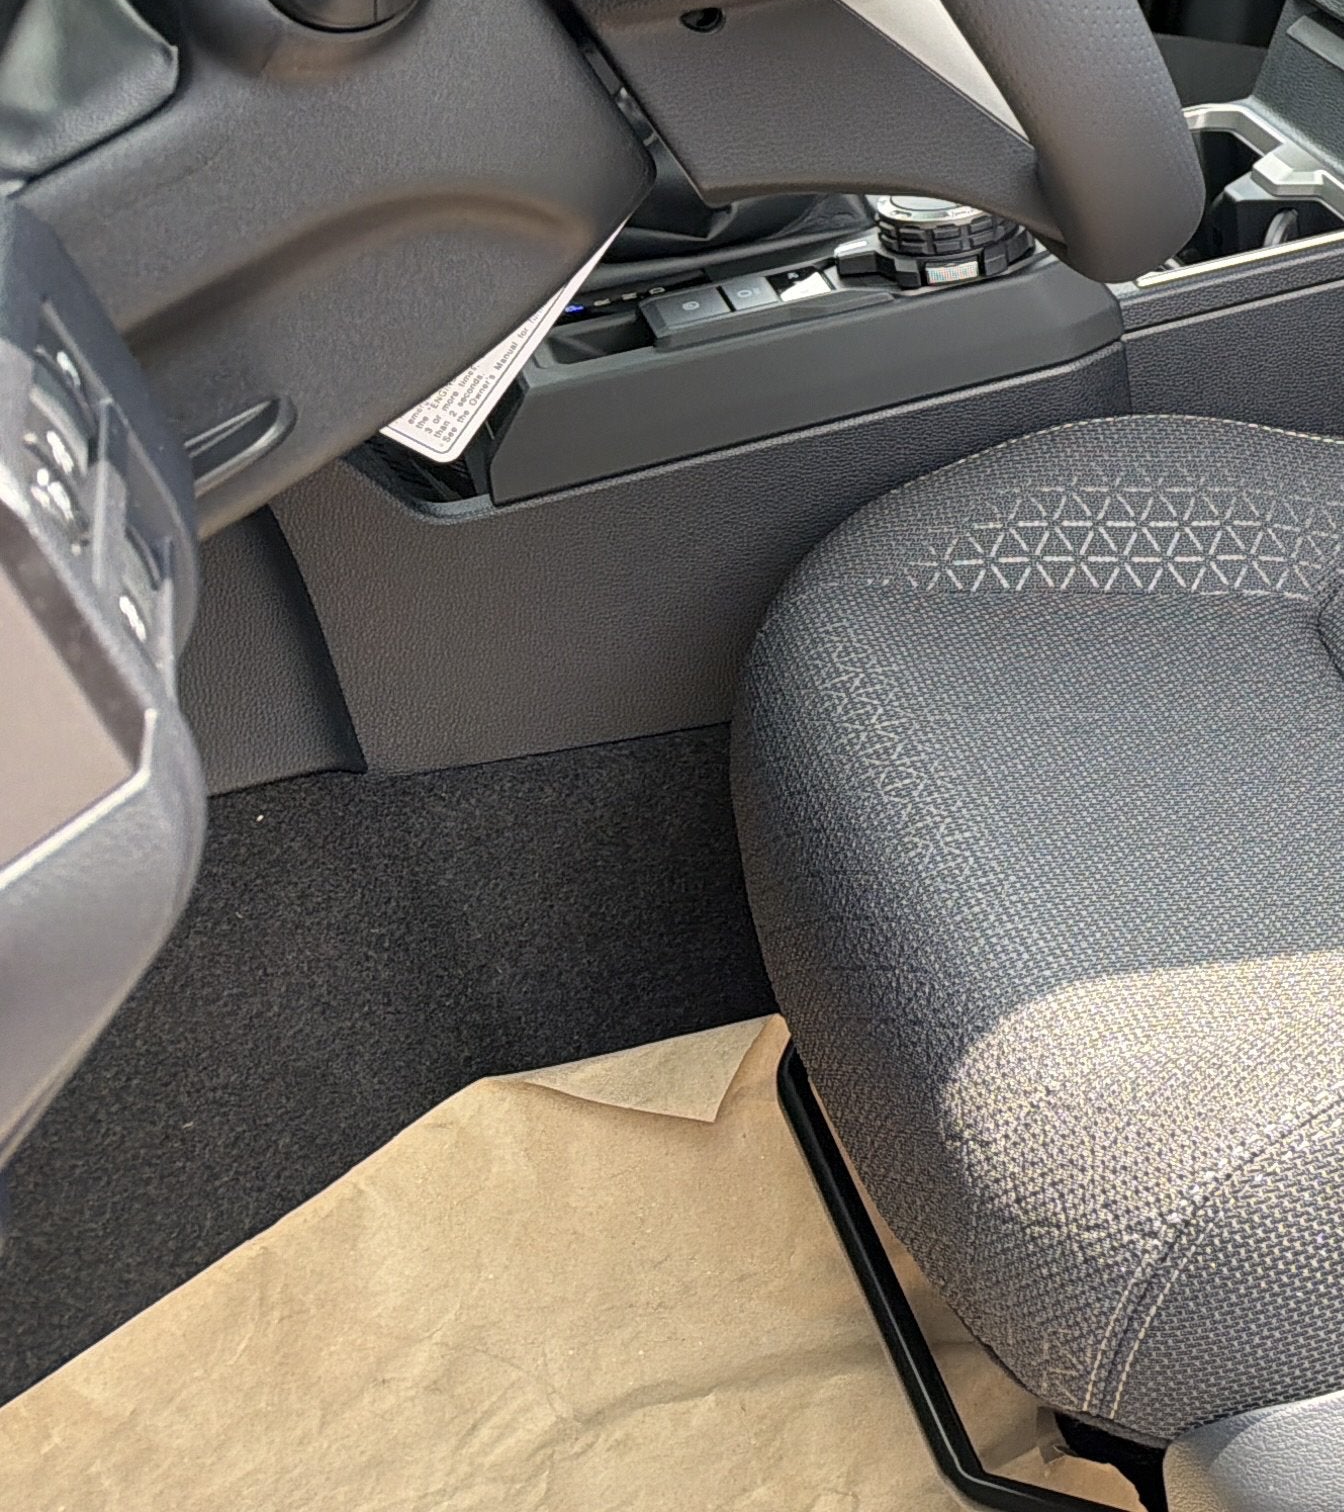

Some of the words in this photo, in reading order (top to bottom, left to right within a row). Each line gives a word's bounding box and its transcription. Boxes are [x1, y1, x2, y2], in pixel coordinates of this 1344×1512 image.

[443, 427, 458, 443] See
[457, 410, 470, 424] the
[469, 374, 497, 407] Owner's
[494, 341, 518, 371] Manual
[517, 326, 529, 339] for
[433, 415, 442, 425] or
[442, 391, 460, 412] more
[434, 421, 451, 439] than
